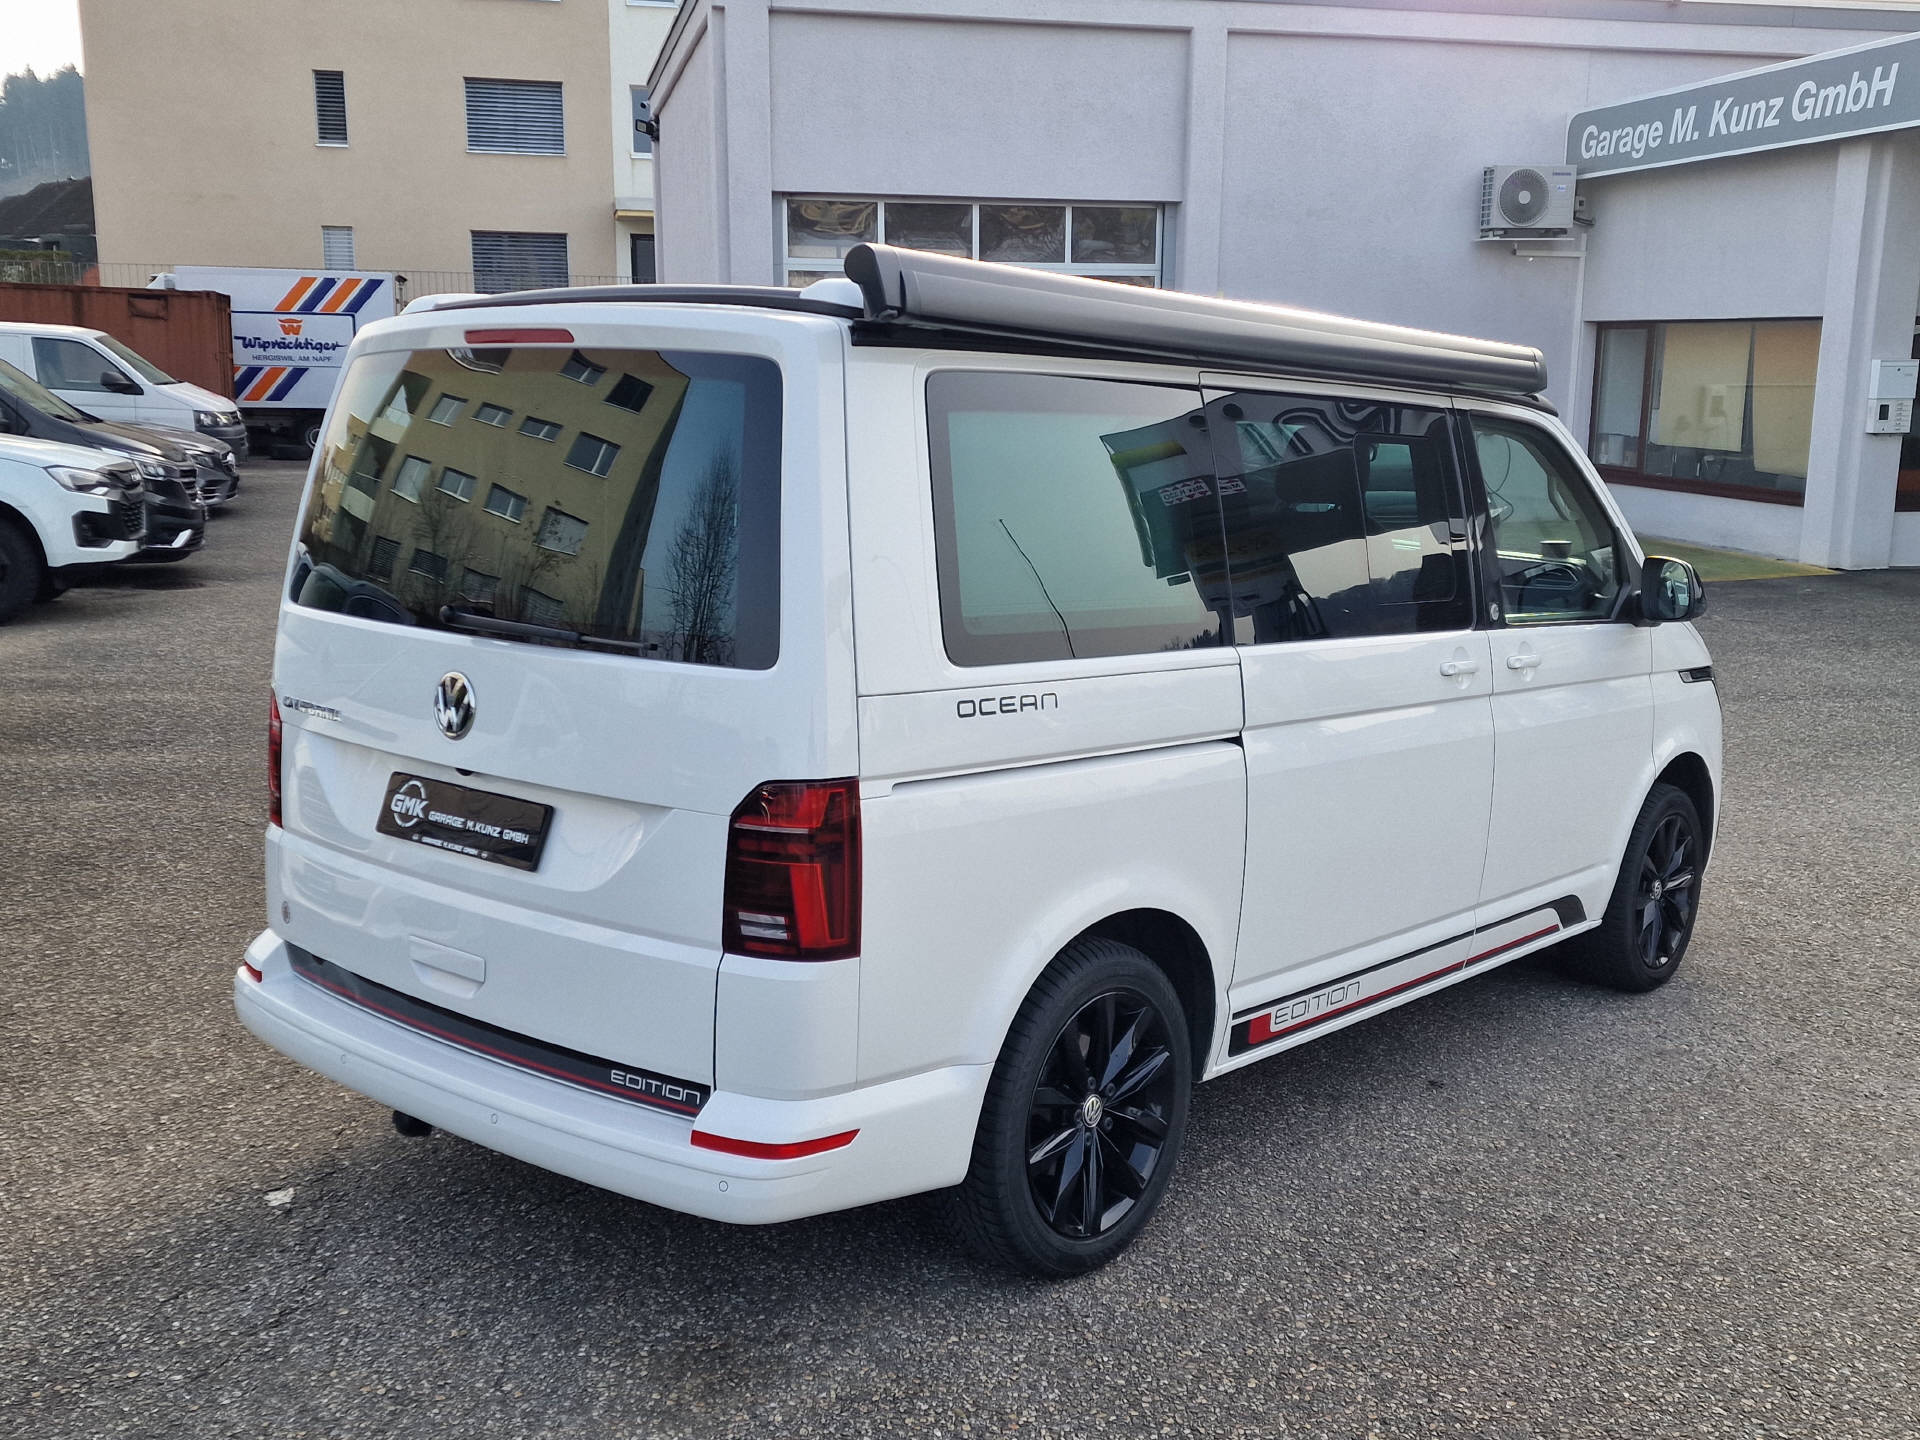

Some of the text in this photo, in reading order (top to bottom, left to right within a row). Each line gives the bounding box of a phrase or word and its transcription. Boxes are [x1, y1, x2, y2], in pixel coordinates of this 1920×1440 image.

[1581, 62, 1900, 160] Garage M. Kunz GmbH
[234, 336, 348, 353] Wiprächtiger
[252, 354, 295, 362] HERGISWIL
[312, 355, 333, 363] NAPF
[957, 693, 1058, 718] OCEAN
[390, 793, 430, 819] GMK
[428, 810, 466, 828] GARAGE
[502, 829, 530, 845] GMBH
[1274, 981, 1361, 1026] EDITION
[610, 1069, 701, 1106] EDITION
